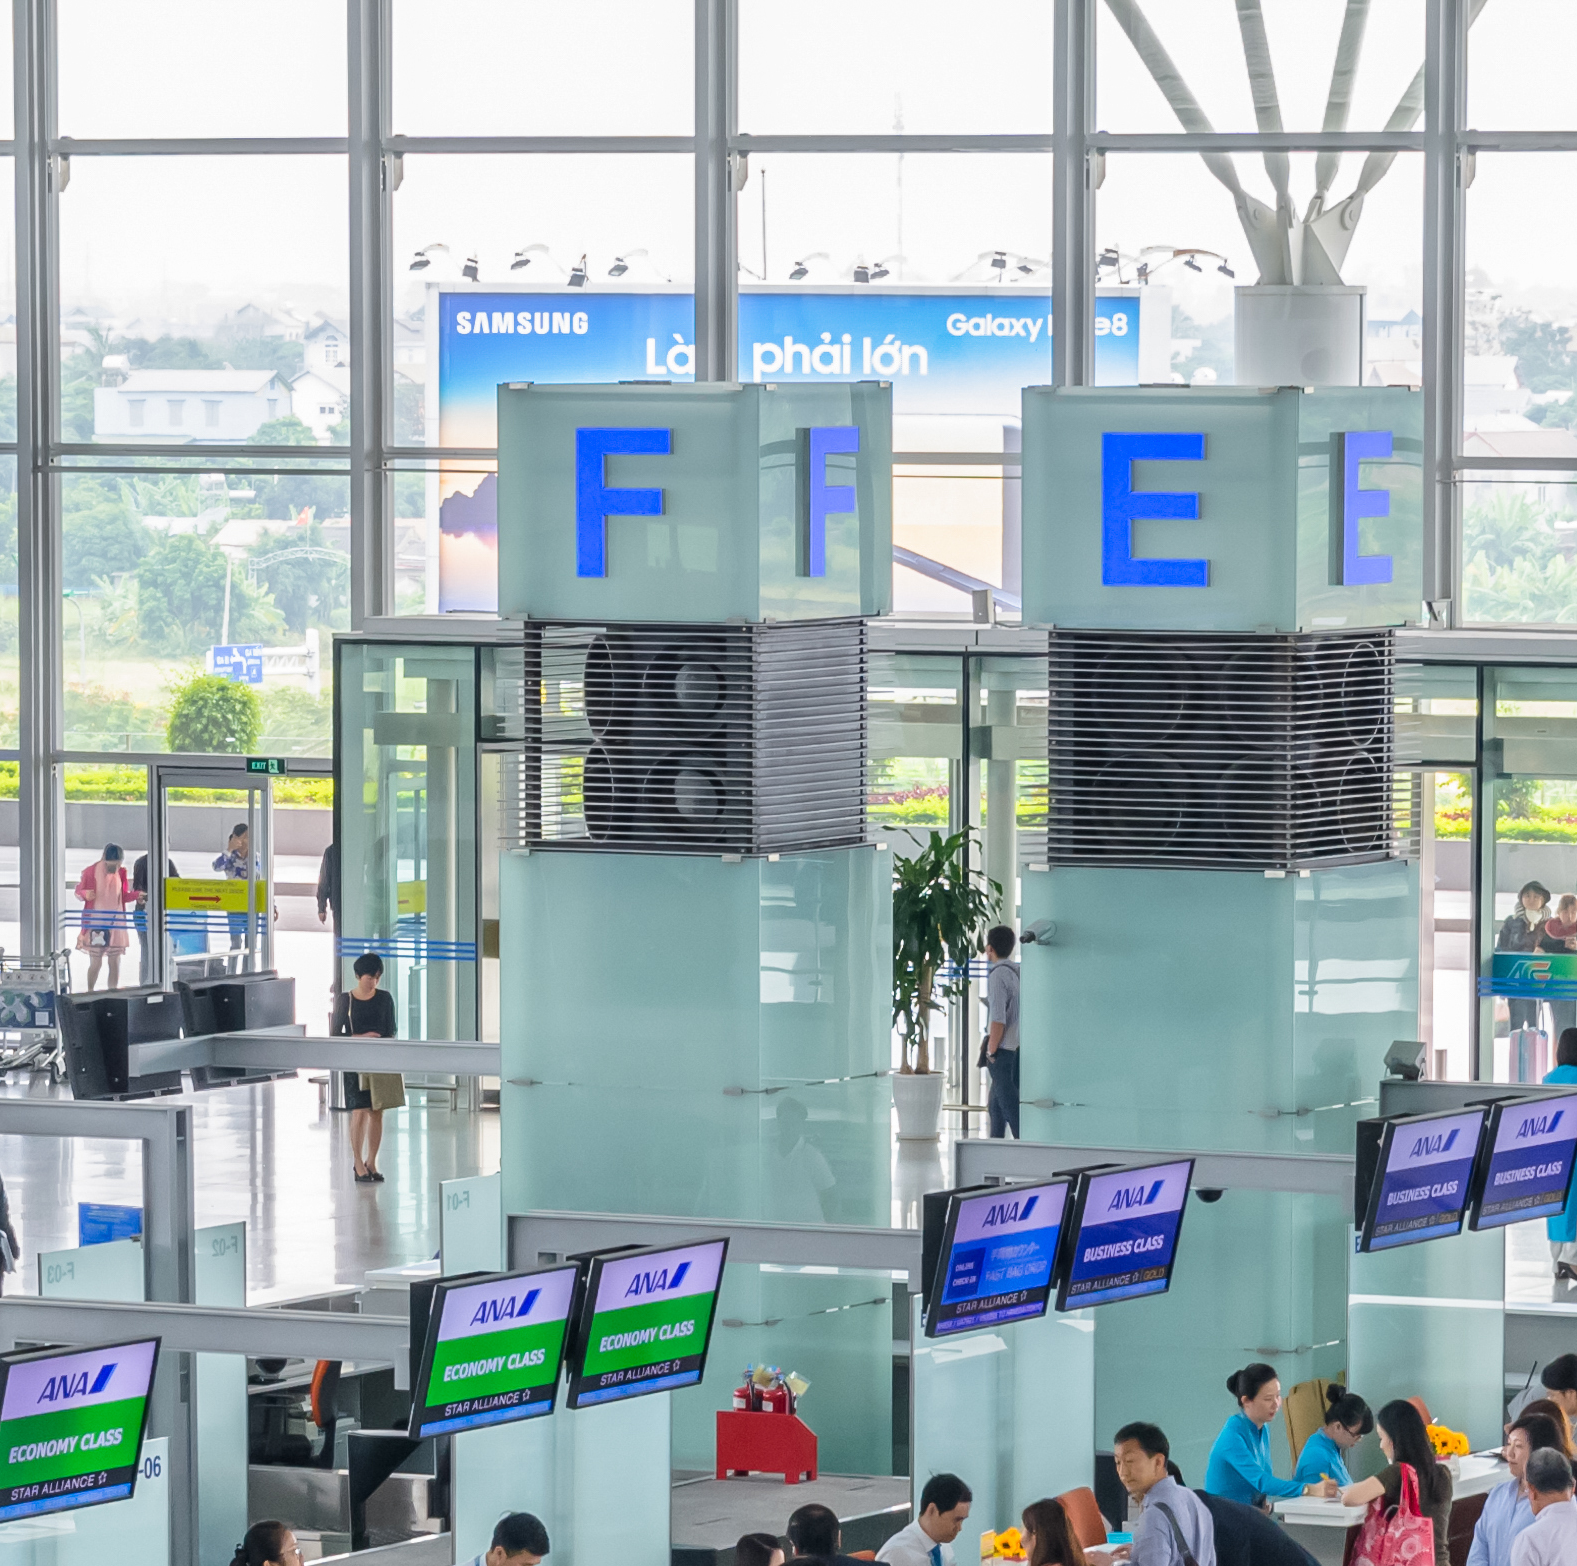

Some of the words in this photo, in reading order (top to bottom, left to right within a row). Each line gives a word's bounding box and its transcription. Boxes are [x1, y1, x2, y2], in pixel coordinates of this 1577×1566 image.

[456, 312, 588, 335] SAMSUNG
[946, 313, 1043, 342] Galaxy
[646, 338, 695, 375] Là
[752, 336, 852, 383] phải
[862, 337, 928, 375] lớn
[577, 427, 671, 577] F
[807, 427, 859, 577] F
[1102, 432, 1208, 587] E
[1341, 431, 1393, 585] E
[1515, 1115, 1548, 1139] ANA
[1409, 1134, 1443, 1158] ANA
[1493, 1166, 1535, 1186] BUSINESS
[1536, 1161, 1562, 1177] CLASS
[1107, 1185, 1145, 1212] ANA
[1387, 1185, 1431, 1205] BUSINESS
[1432, 1180, 1458, 1197] CLASS
[1481, 1204, 1500, 1216] STAR
[1501, 1197, 1534, 1213] ALLIANCE
[982, 1202, 1019, 1228] ANA
[1375, 1225, 1393, 1237] STAR
[1394, 1217, 1428, 1233] ALLIANCE
[1083, 1241, 1132, 1263] BUSINESS
[1133, 1234, 1164, 1252] CLASS
[624, 1269, 668, 1298] ANA
[1071, 1283, 1091, 1295] STAR
[1092, 1275, 1131, 1292] ALLIANCE
[1144, 1267, 1165, 1281] GOLD
[470, 1296, 517, 1326] ANA
[956, 1301, 977, 1313] STAR
[978, 1292, 1018, 1310] ALLIANCE
[599, 1327, 656, 1353] ECONOMY
[658, 1320, 695, 1340] CLASS
[443, 1356, 506, 1382] ECONOMY
[507, 1348, 546, 1369] CLASS
[600, 1371, 625, 1386] STAR
[626, 1362, 671, 1381] ALLIANCE
[37, 1371, 90, 1404] ANA
[444, 1401, 470, 1417] STAR
[472, 1392, 520, 1412] ALLIANCE
[9, 1436, 78, 1464] ECONOMY
[80, 1427, 123, 1451] CLASS
[11, 1485, 39, 1500] STAR
[41, 1474, 95, 1495] ALLIANCE
